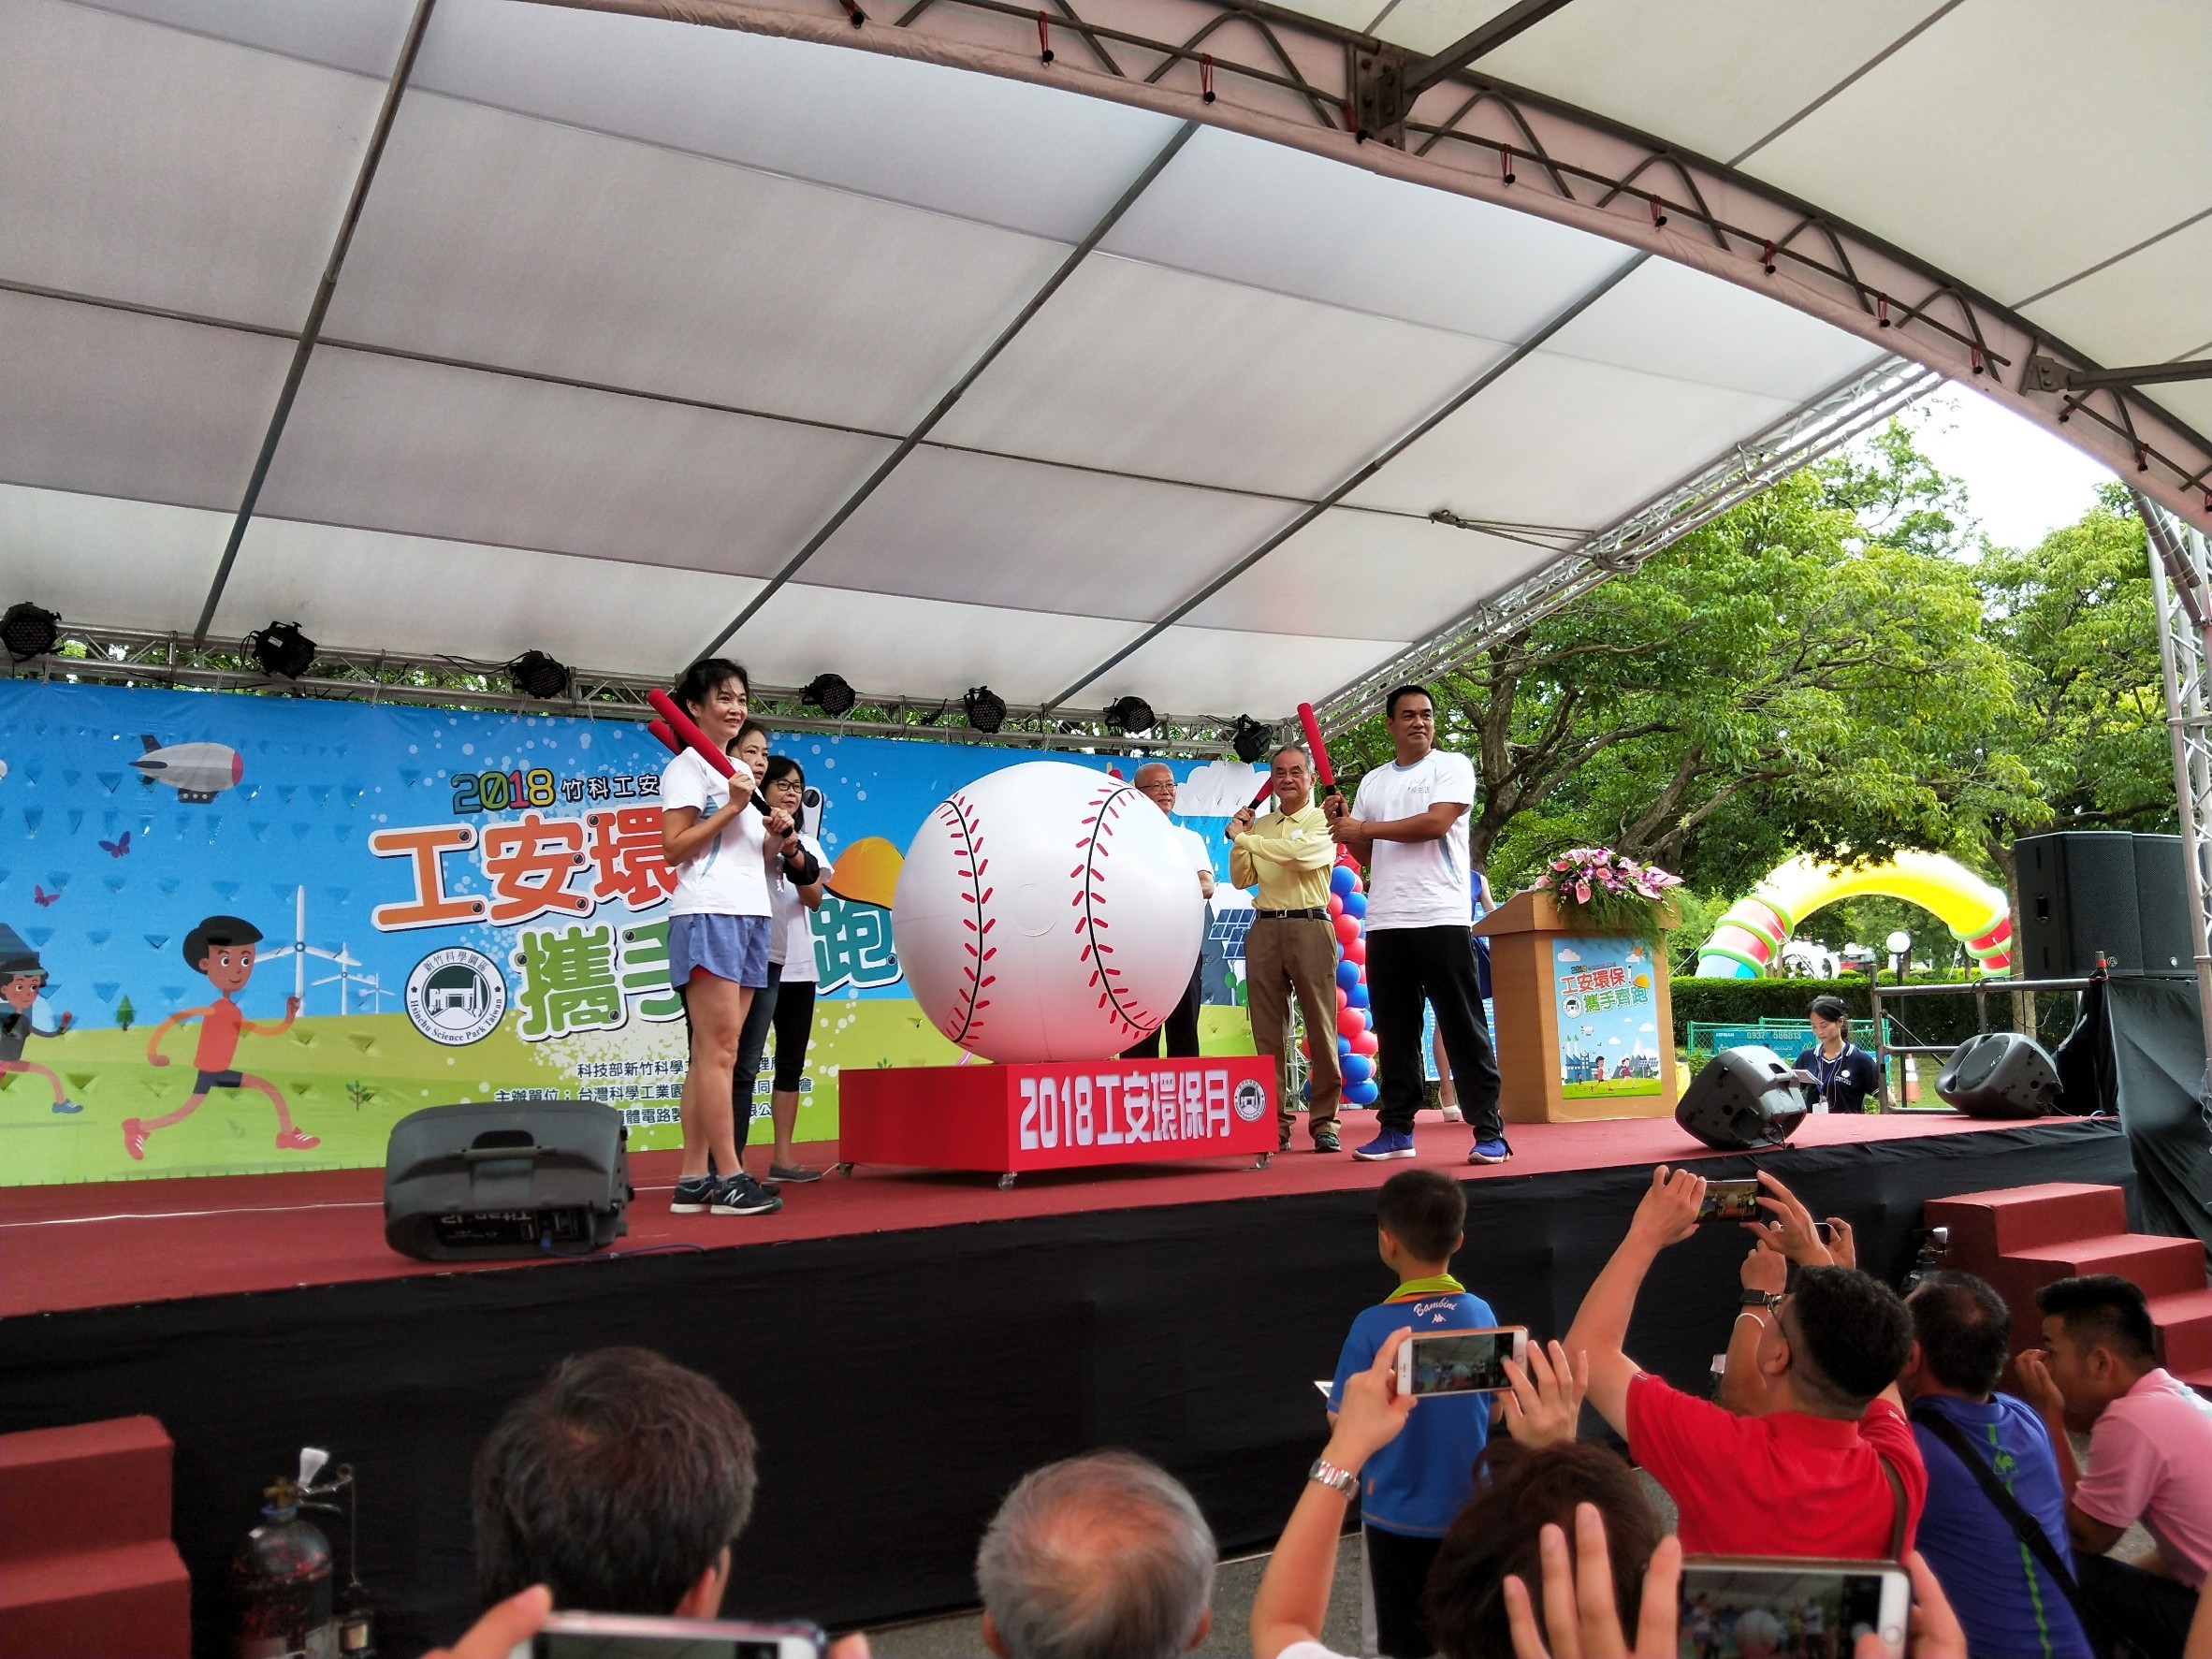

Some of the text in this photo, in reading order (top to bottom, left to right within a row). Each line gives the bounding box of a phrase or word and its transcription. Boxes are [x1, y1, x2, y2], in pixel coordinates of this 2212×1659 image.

[451, 768, 555, 814] 2018
[423, 951, 490, 972] 新竹科學園區
[1582, 986, 1649, 1013] 攜手齊跑
[410, 998, 502, 1041] Hsinchu Science Park Taiwan
[1020, 1070, 1231, 1150] 2018工安環保月
[1413, 1297, 1458, 1317] Bambini
